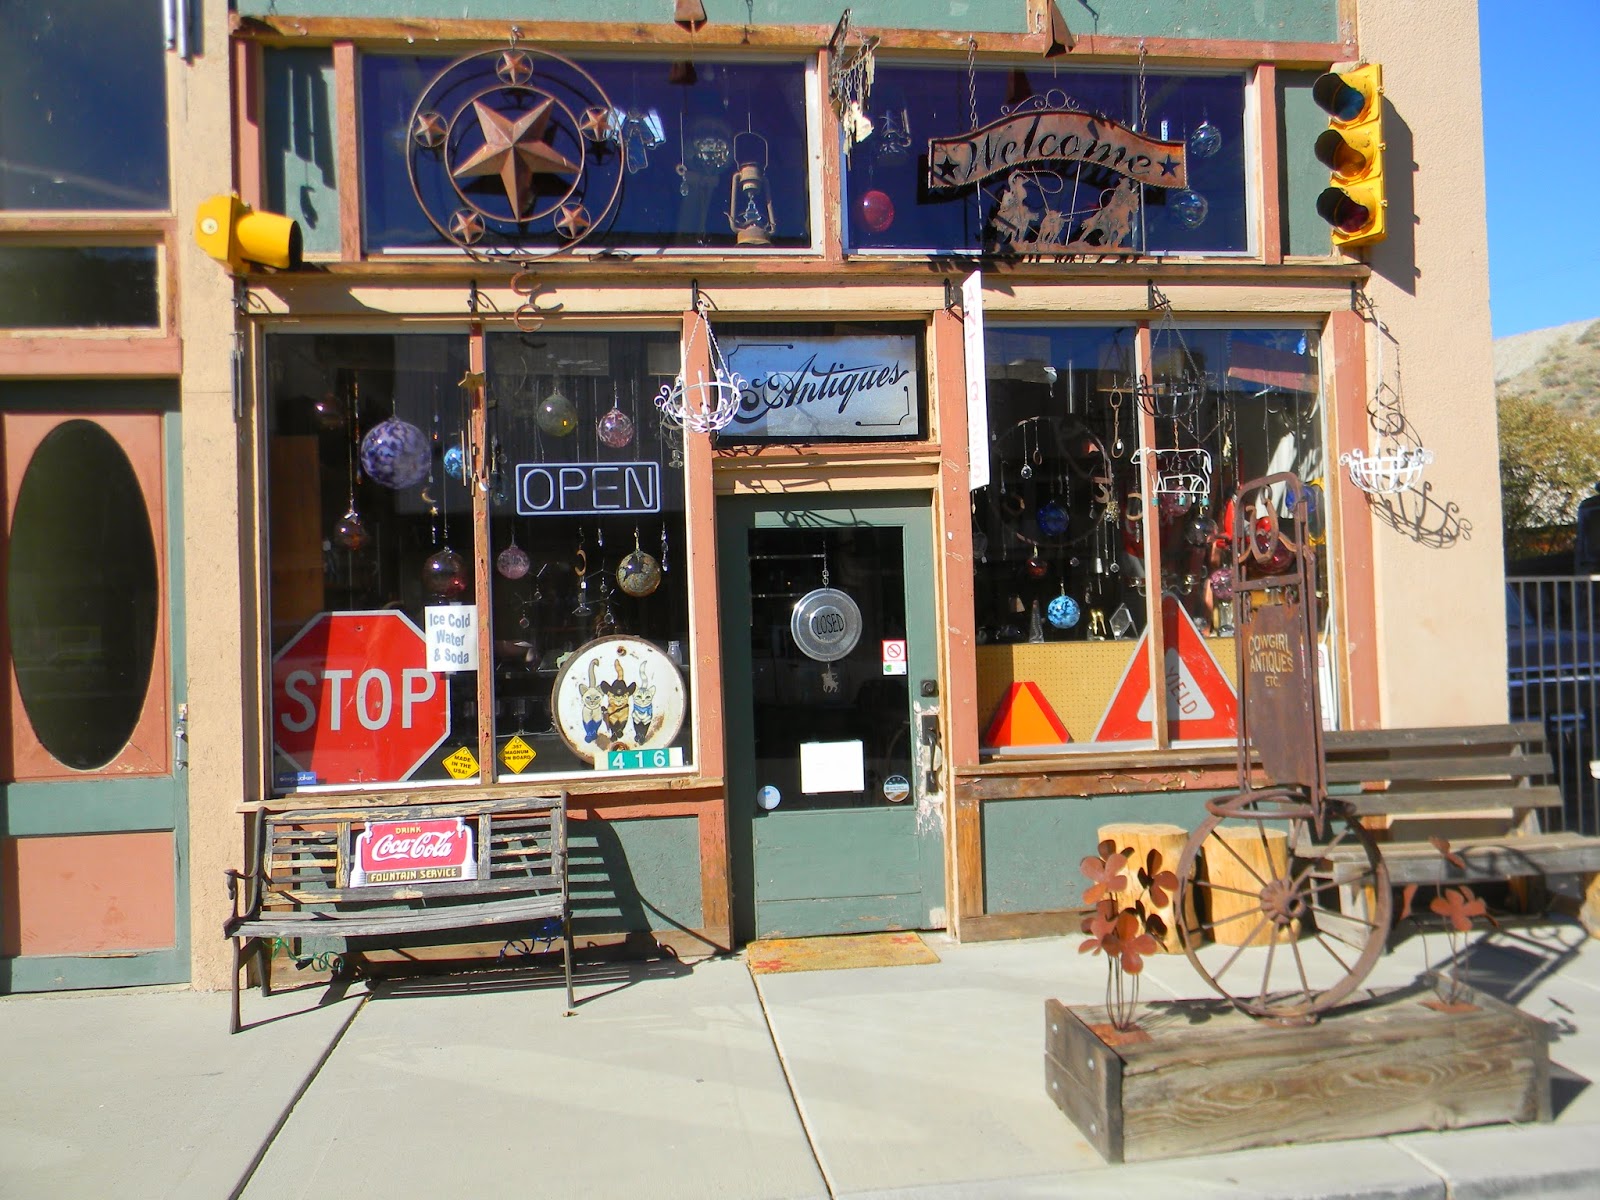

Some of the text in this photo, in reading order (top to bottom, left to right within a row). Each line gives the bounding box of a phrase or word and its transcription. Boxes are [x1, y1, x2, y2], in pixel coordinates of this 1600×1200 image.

[963, 112, 1152, 179] Welcome
[735, 352, 909, 424] Antiques
[523, 467, 653, 510] OPEN
[429, 613, 471, 628] Ice Cold
[811, 613, 845, 639] CLOSED
[436, 629, 466, 647] Water
[1248, 633, 1293, 657] COWGIRL
[434, 648, 470, 664] & Soda
[1250, 651, 1294, 675] ANTIQUES
[280, 668, 437, 733] STOP
[1166, 665, 1198, 714] YIELD
[453, 755, 472, 763] MADE
[612, 750, 666, 770] 416
[395, 826, 422, 835] DRINK
[371, 831, 455, 862] Coca-Cola
[371, 868, 457, 882] FOUNTAIN SERVICE
